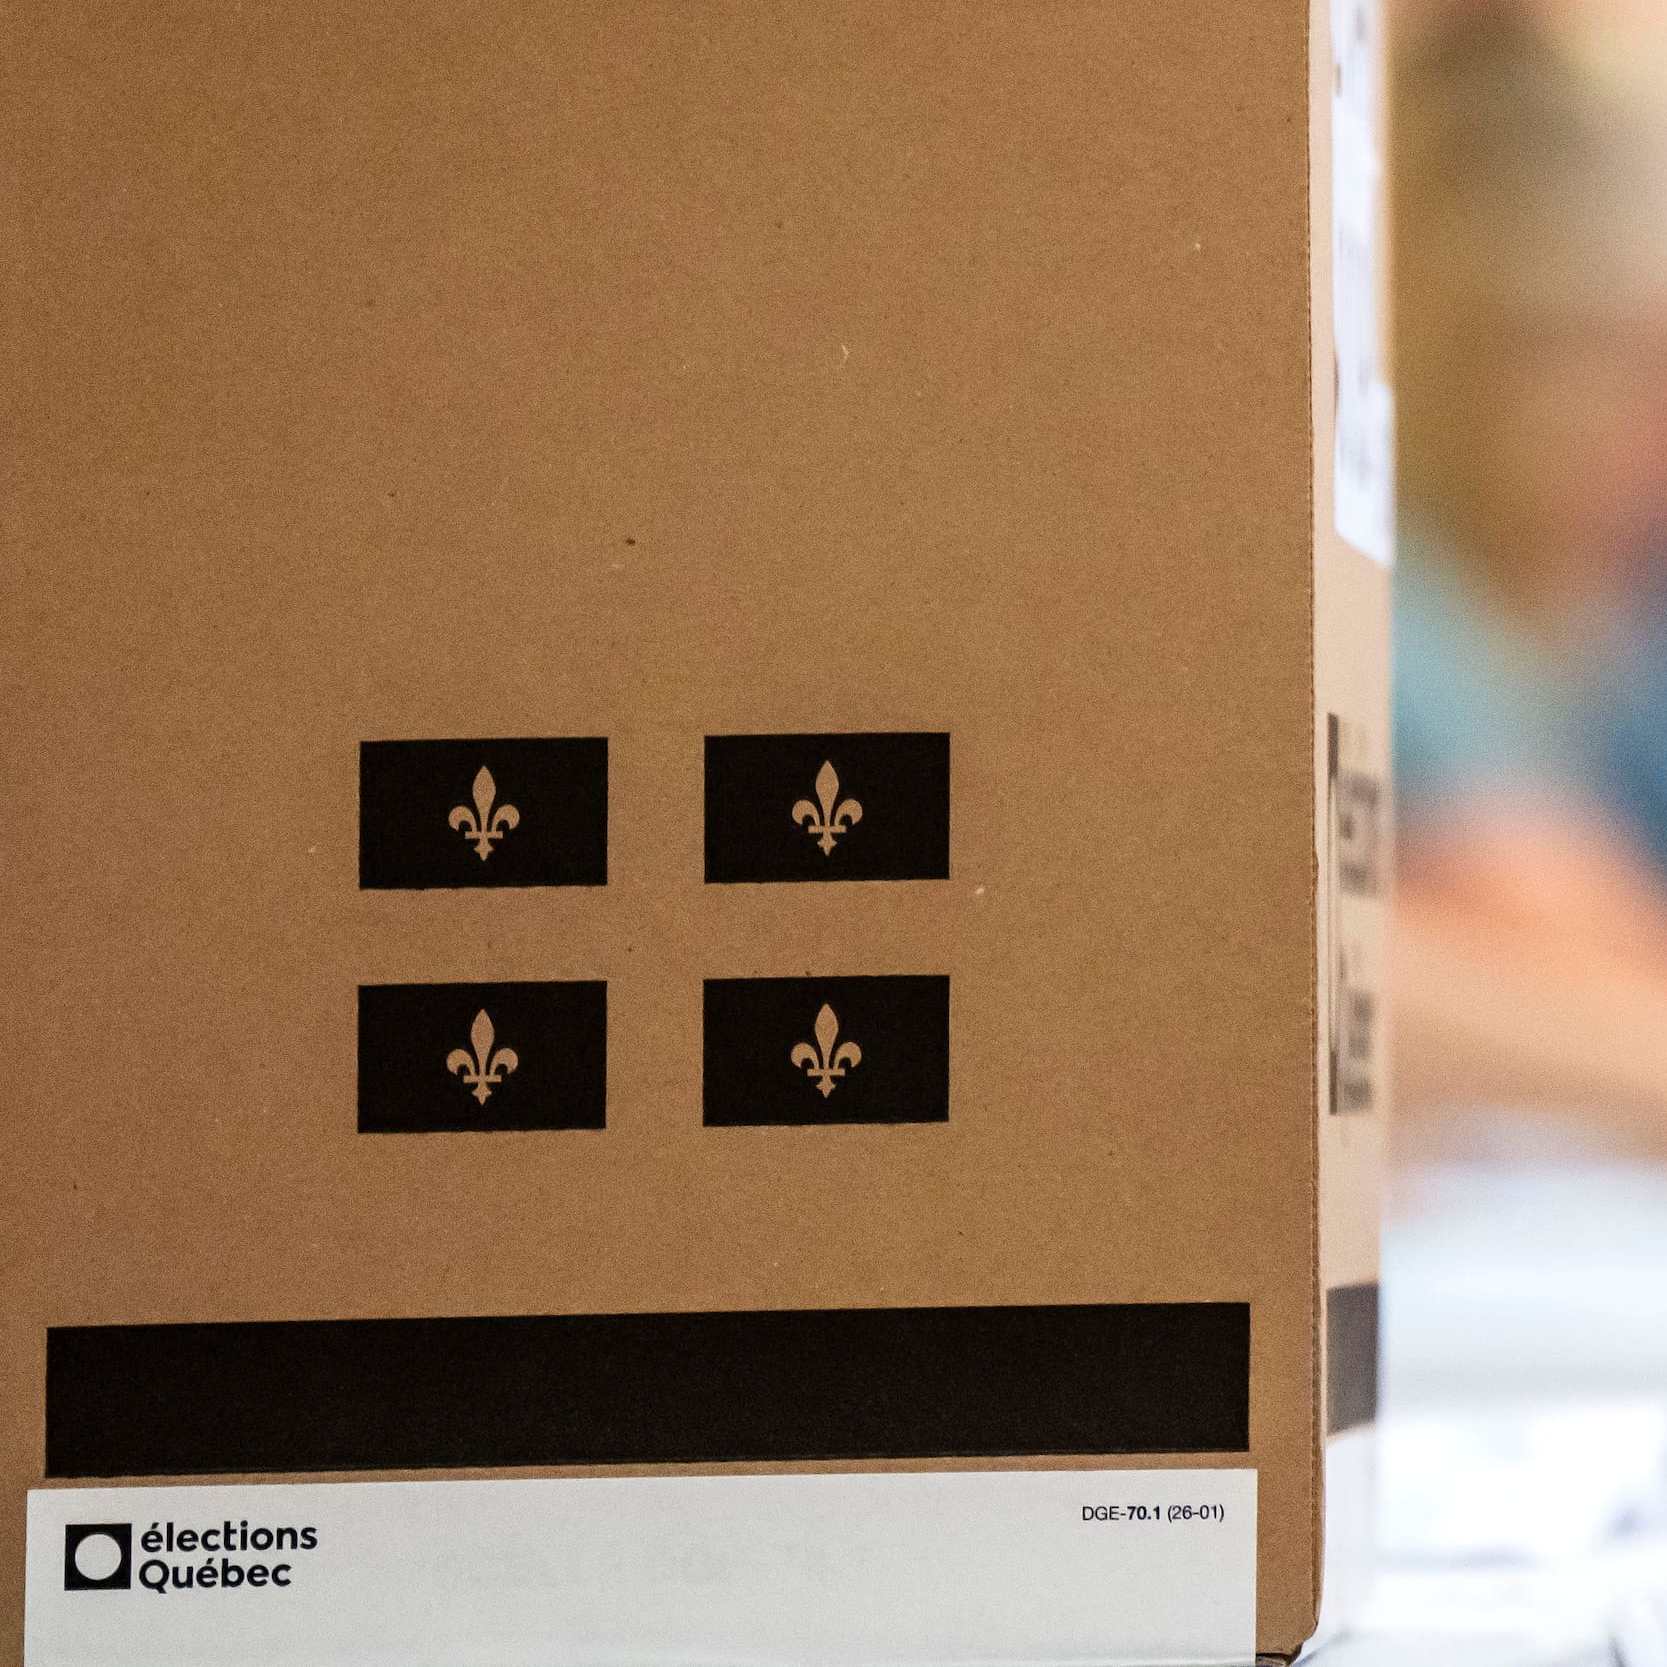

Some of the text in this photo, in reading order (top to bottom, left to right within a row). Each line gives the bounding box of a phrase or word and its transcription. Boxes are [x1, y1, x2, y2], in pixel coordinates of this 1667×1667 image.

[1082, 1504, 1225, 1523] DGE-70.1 (26-01)
[140, 1519, 318, 1554] élections
[138, 1557, 292, 1595] Québec
